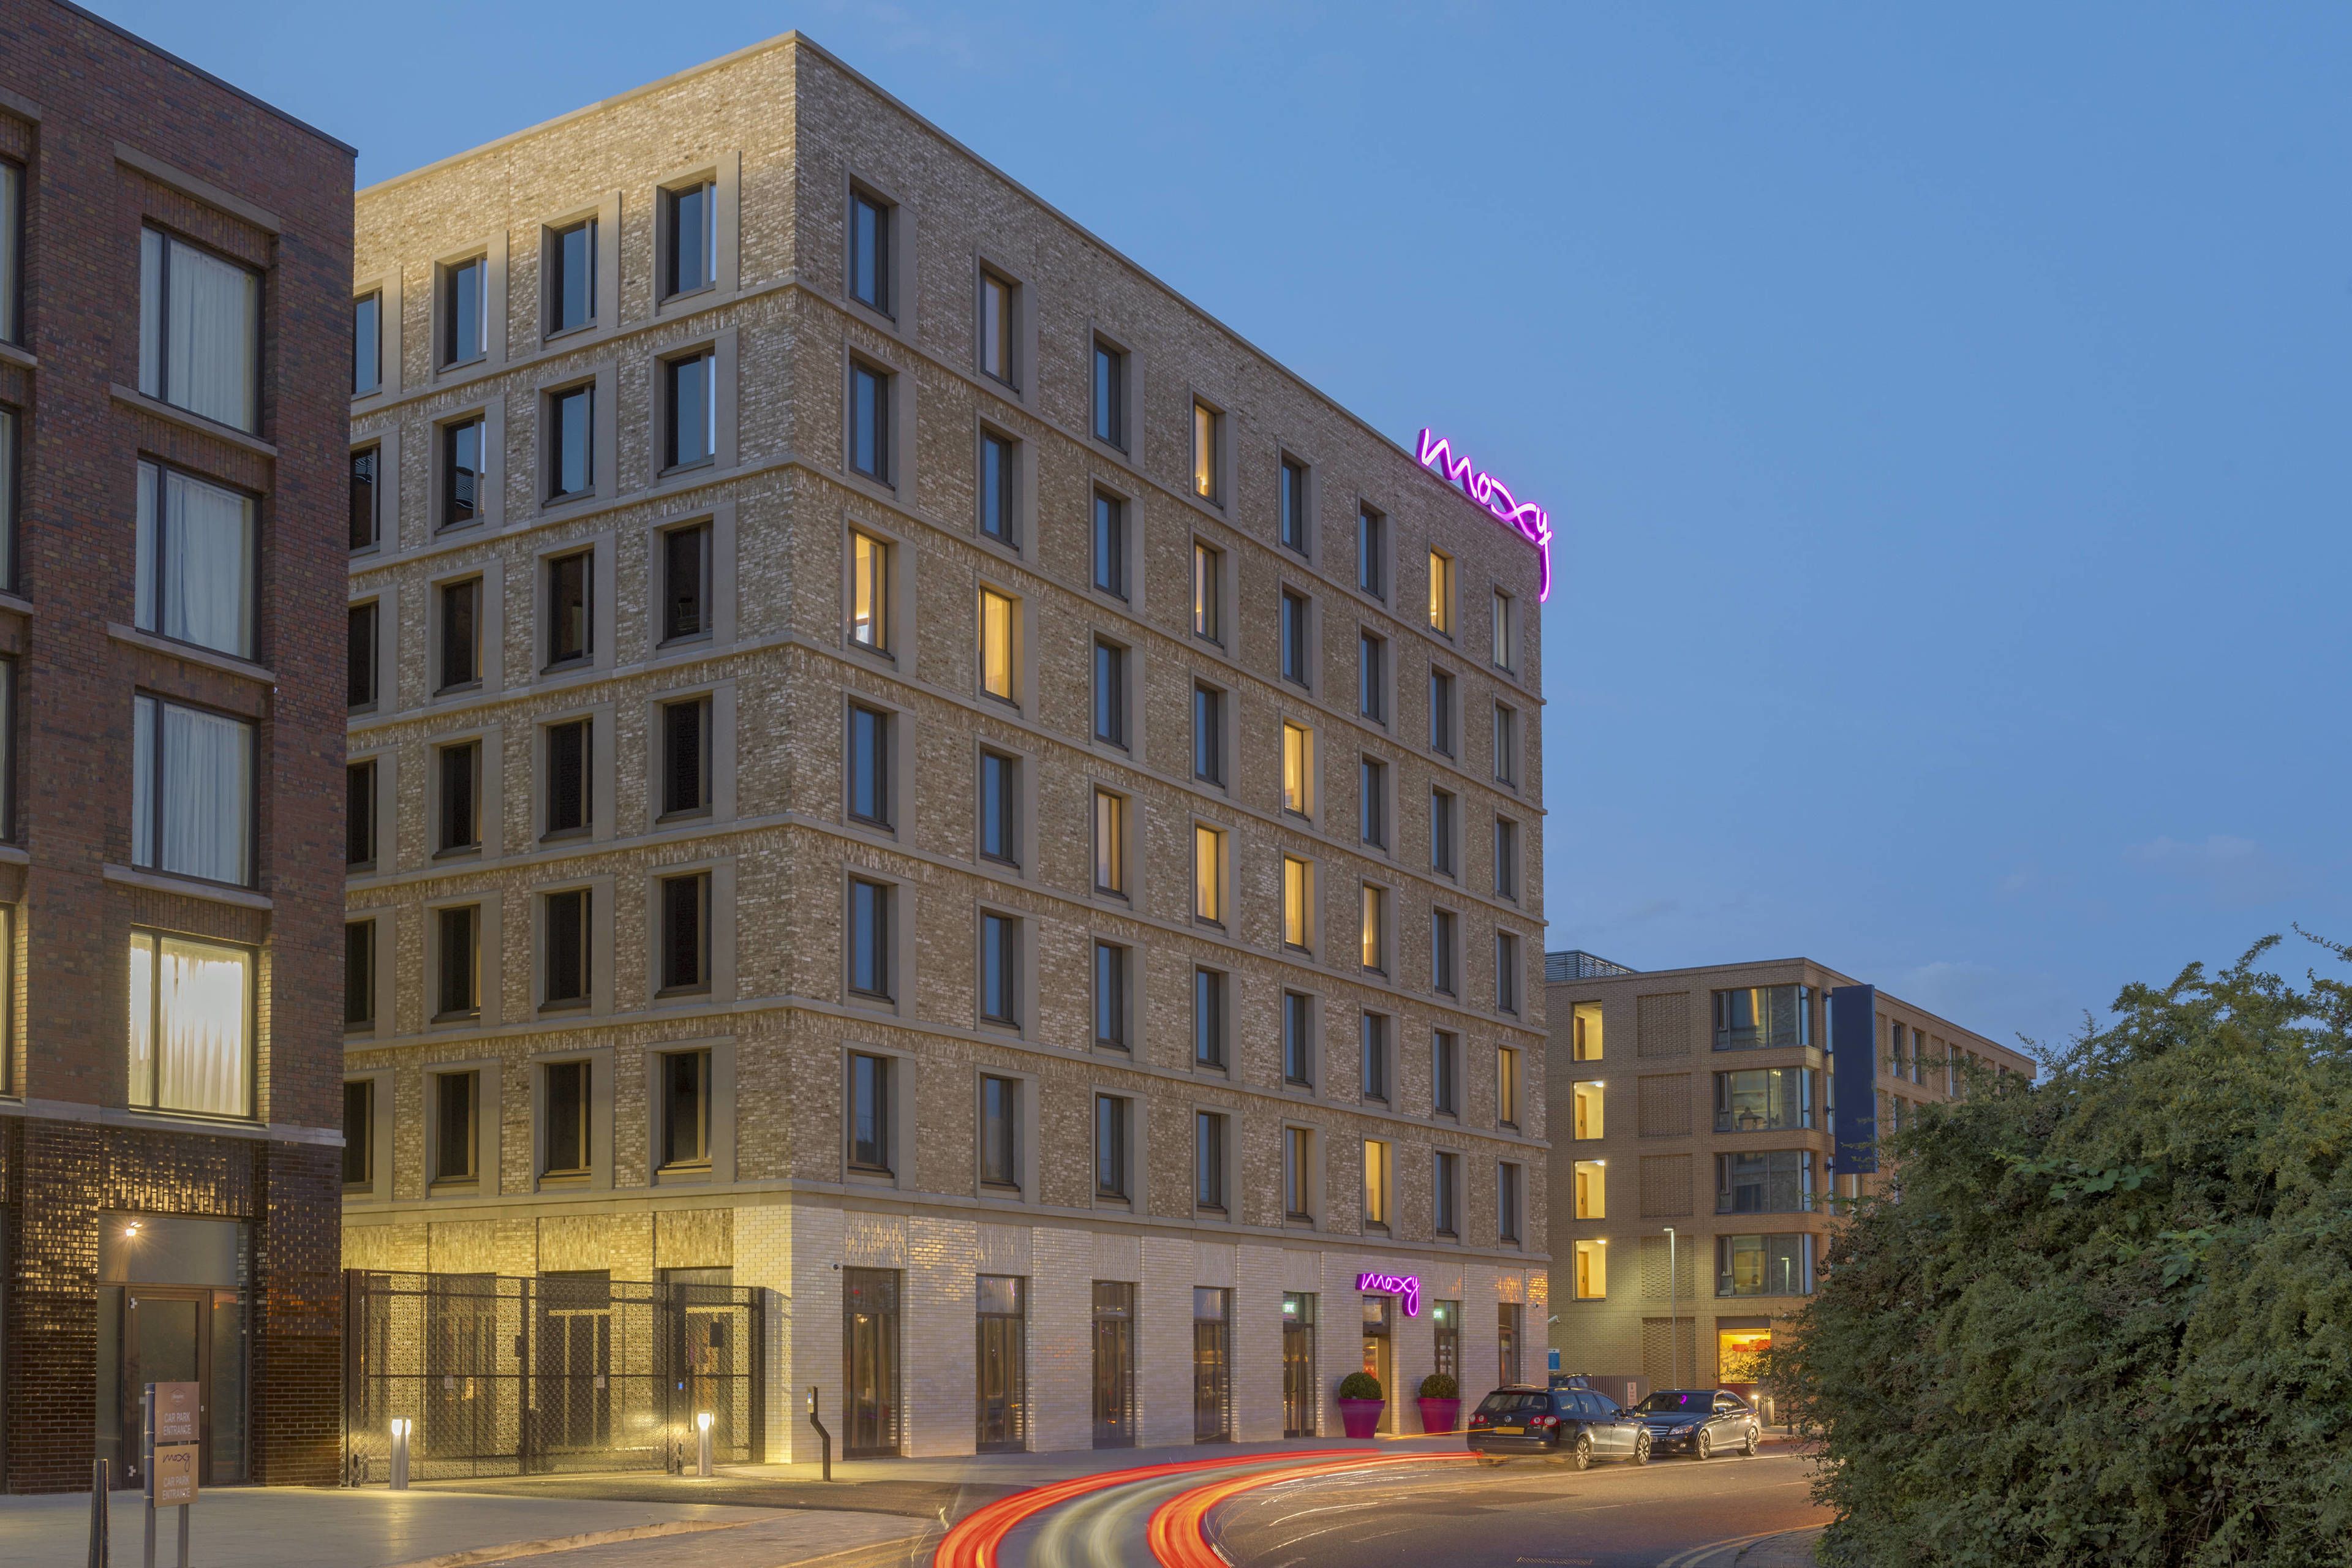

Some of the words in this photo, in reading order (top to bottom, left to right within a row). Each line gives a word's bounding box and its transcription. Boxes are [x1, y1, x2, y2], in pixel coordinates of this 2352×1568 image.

[164, 1413, 176, 1423] CAR
[176, 1412, 190, 1422] PARK
[164, 1425, 191, 1436] ENTRANCE
[163, 1477, 176, 1487] CAR
[176, 1476, 189, 1485] PARK
[162, 1488, 190, 1499] ENTRANCE
